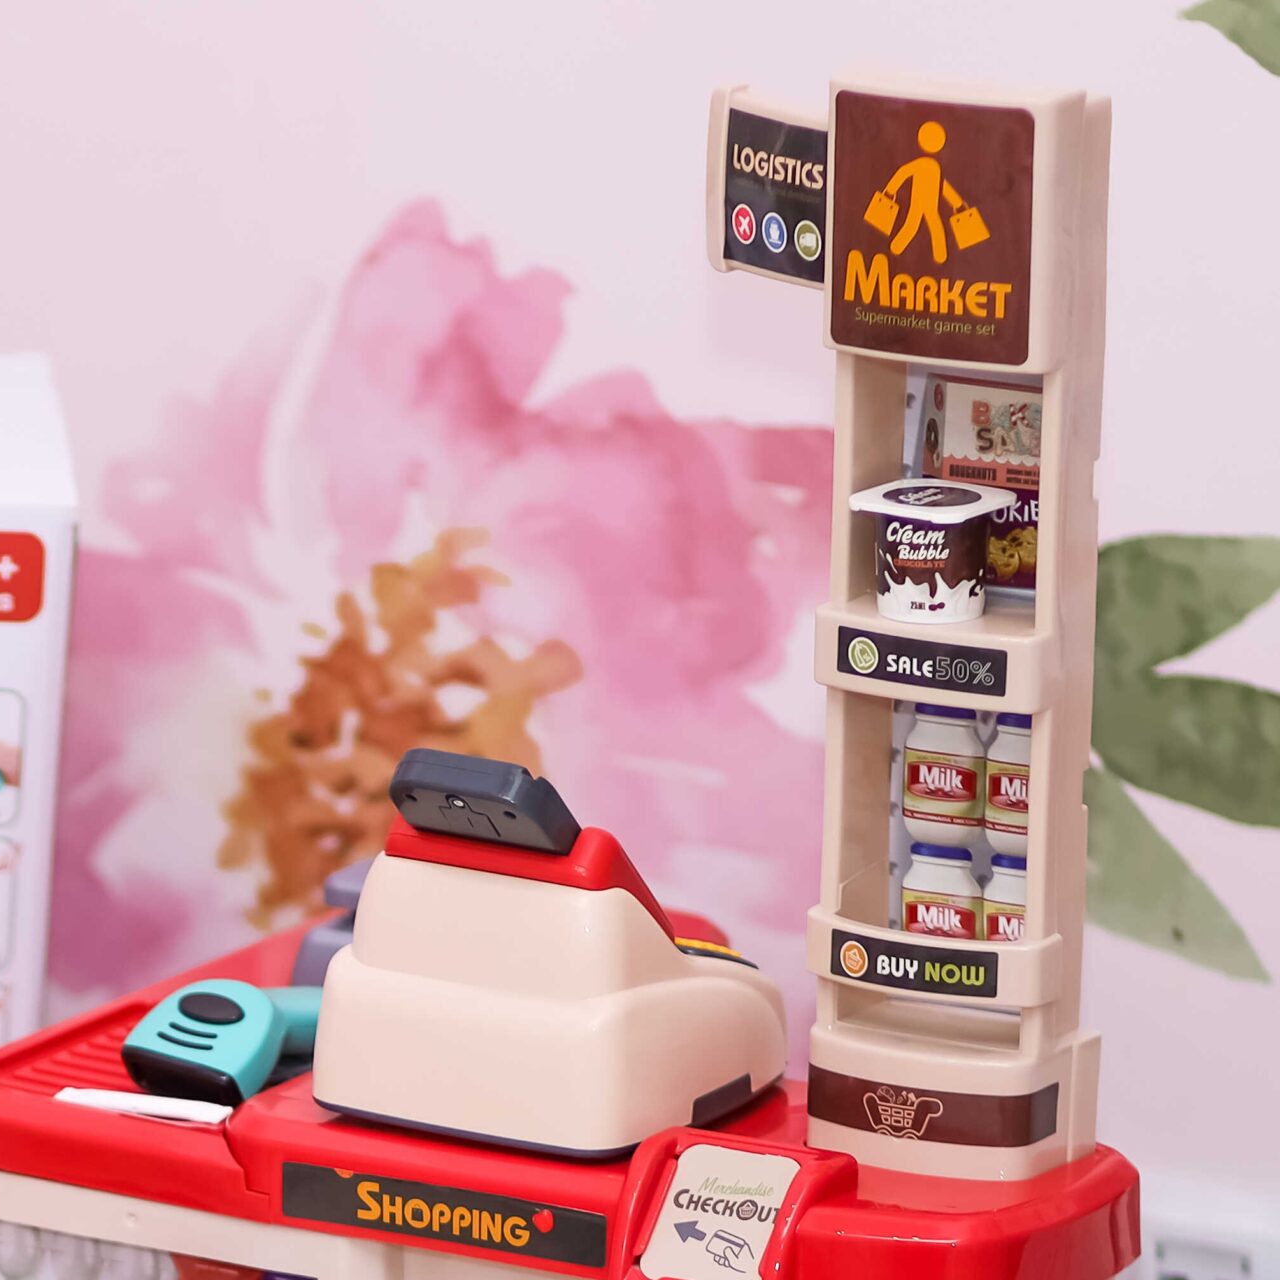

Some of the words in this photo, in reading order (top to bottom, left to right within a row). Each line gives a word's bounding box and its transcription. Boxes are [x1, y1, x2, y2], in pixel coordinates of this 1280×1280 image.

[731, 143, 825, 190] LOGISTICS
[844, 249, 1012, 319] MARKET
[855, 306, 931, 331] Supermarket
[934, 317, 972, 334] game
[975, 322, 996, 336] set
[886, 521, 946, 545] Cream
[897, 544, 950, 561] Bubble
[886, 654, 933, 679] SALE
[919, 765, 964, 792] Milk
[1000, 776, 1028, 801] Mi
[916, 903, 963, 930] Milk
[876, 953, 919, 980] BUY
[924, 960, 986, 987] NOW
[697, 1177, 775, 1197] Merchandise
[356, 1181, 531, 1248] SHOPPING
